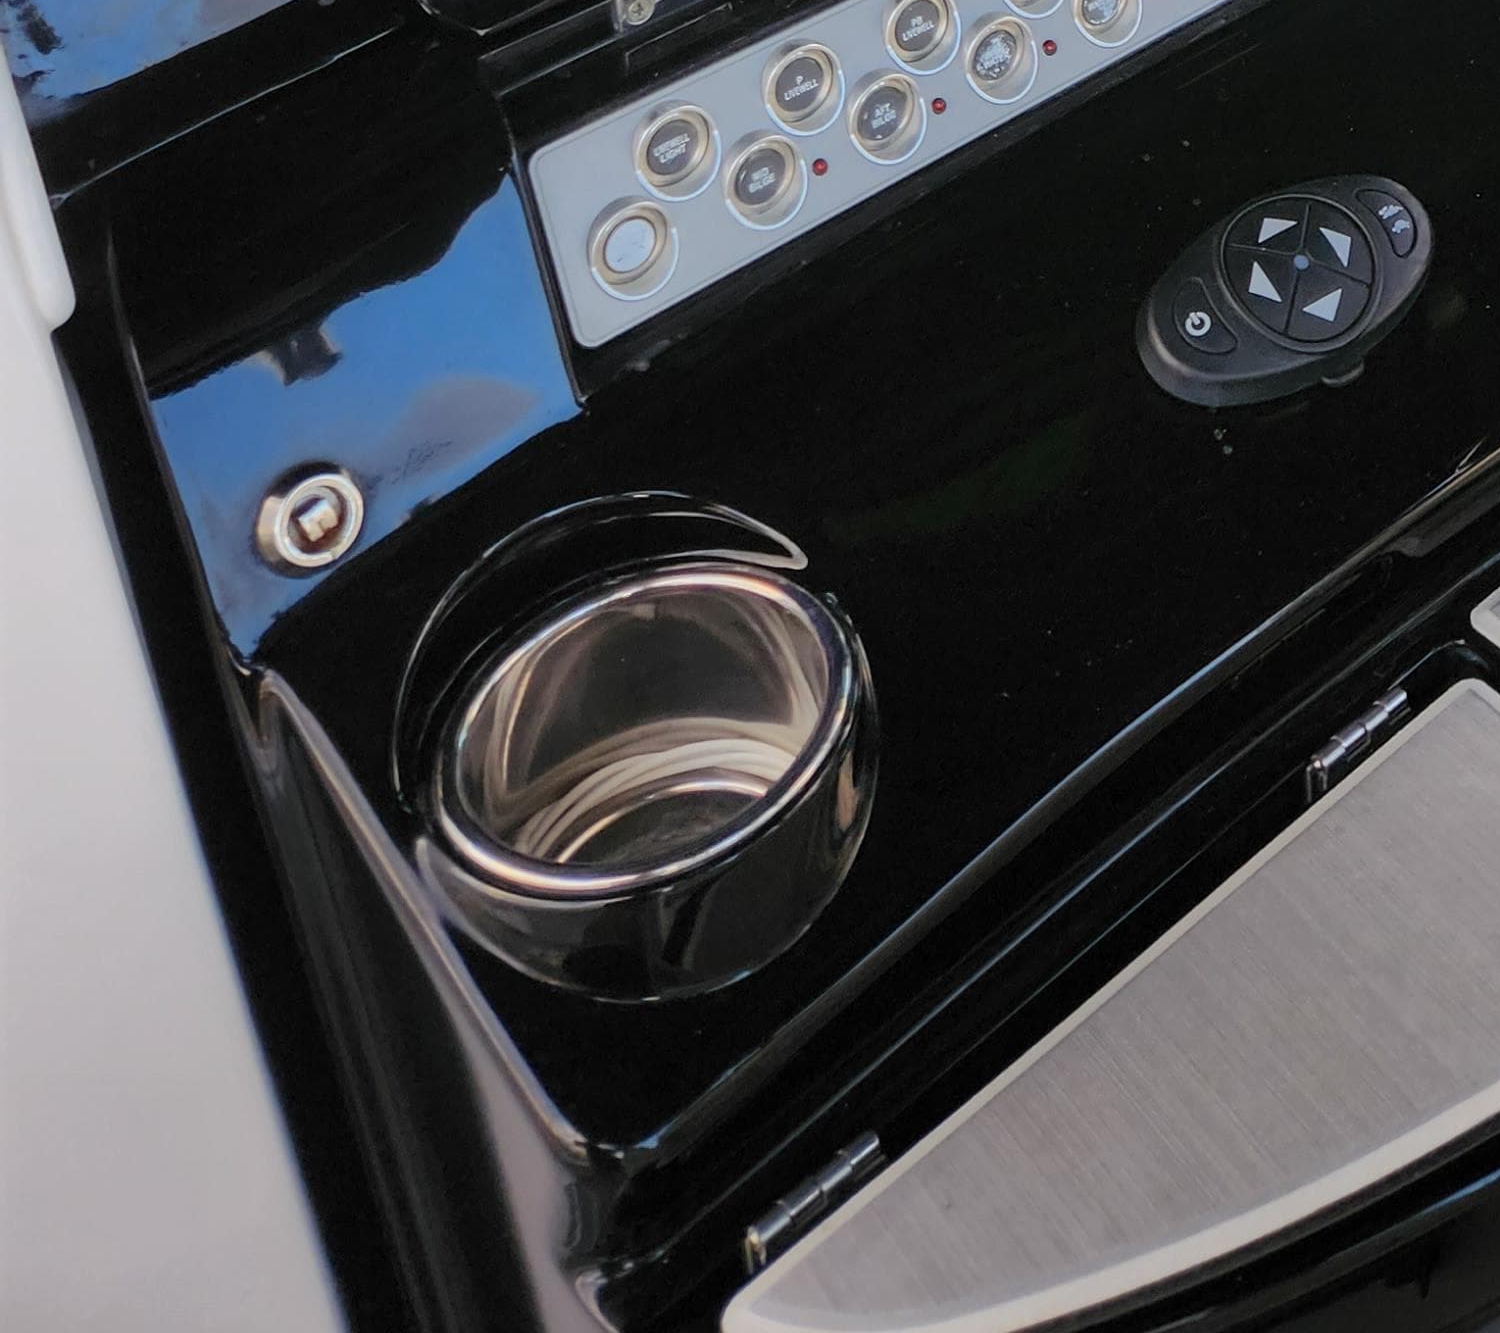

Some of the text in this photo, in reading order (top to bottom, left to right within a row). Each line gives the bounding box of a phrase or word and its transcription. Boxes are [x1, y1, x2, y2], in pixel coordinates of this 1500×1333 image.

[902, 20, 936, 42] LIVEWELL
[784, 79, 819, 101] LIVEWELL
[796, 75, 803, 85] P
[659, 143, 687, 164] LIGHT
